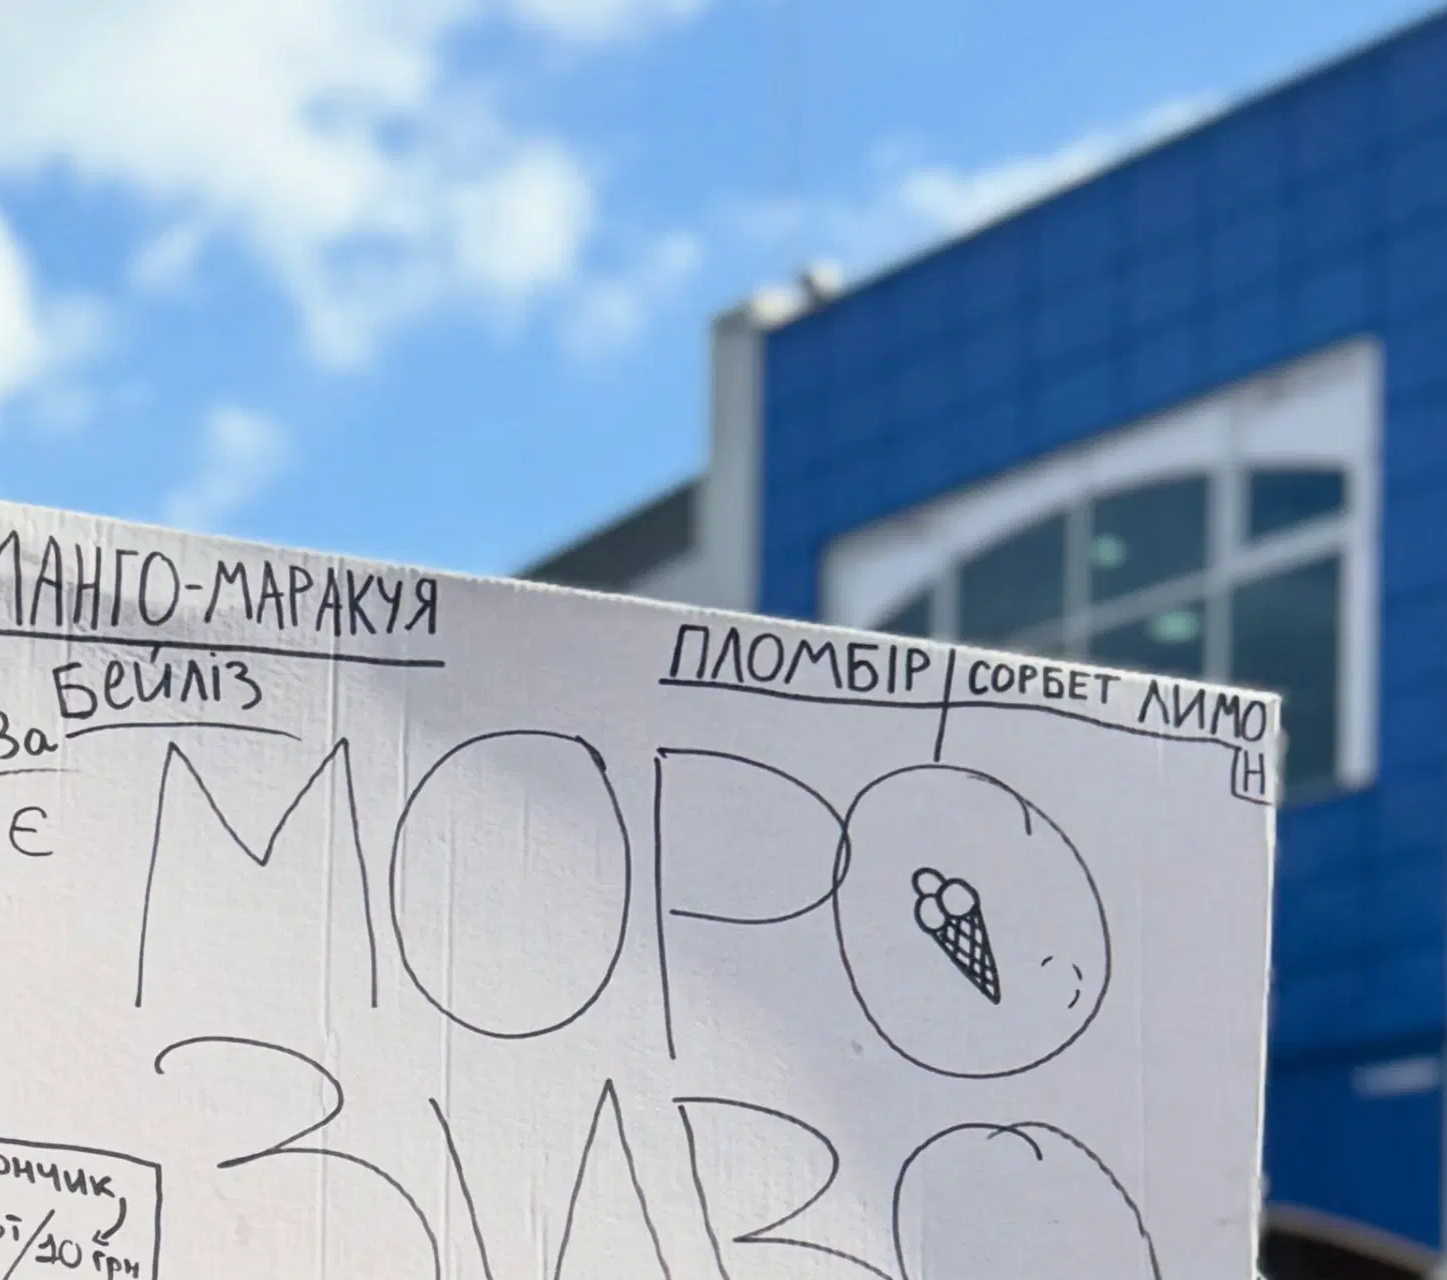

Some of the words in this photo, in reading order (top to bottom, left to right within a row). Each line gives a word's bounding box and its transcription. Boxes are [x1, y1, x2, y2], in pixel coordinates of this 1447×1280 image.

[668, 623, 932, 693] ПЛОМБІР
[967, 658, 1122, 705] СОРБЕТ
[134, 730, 1112, 1080] МОРО
